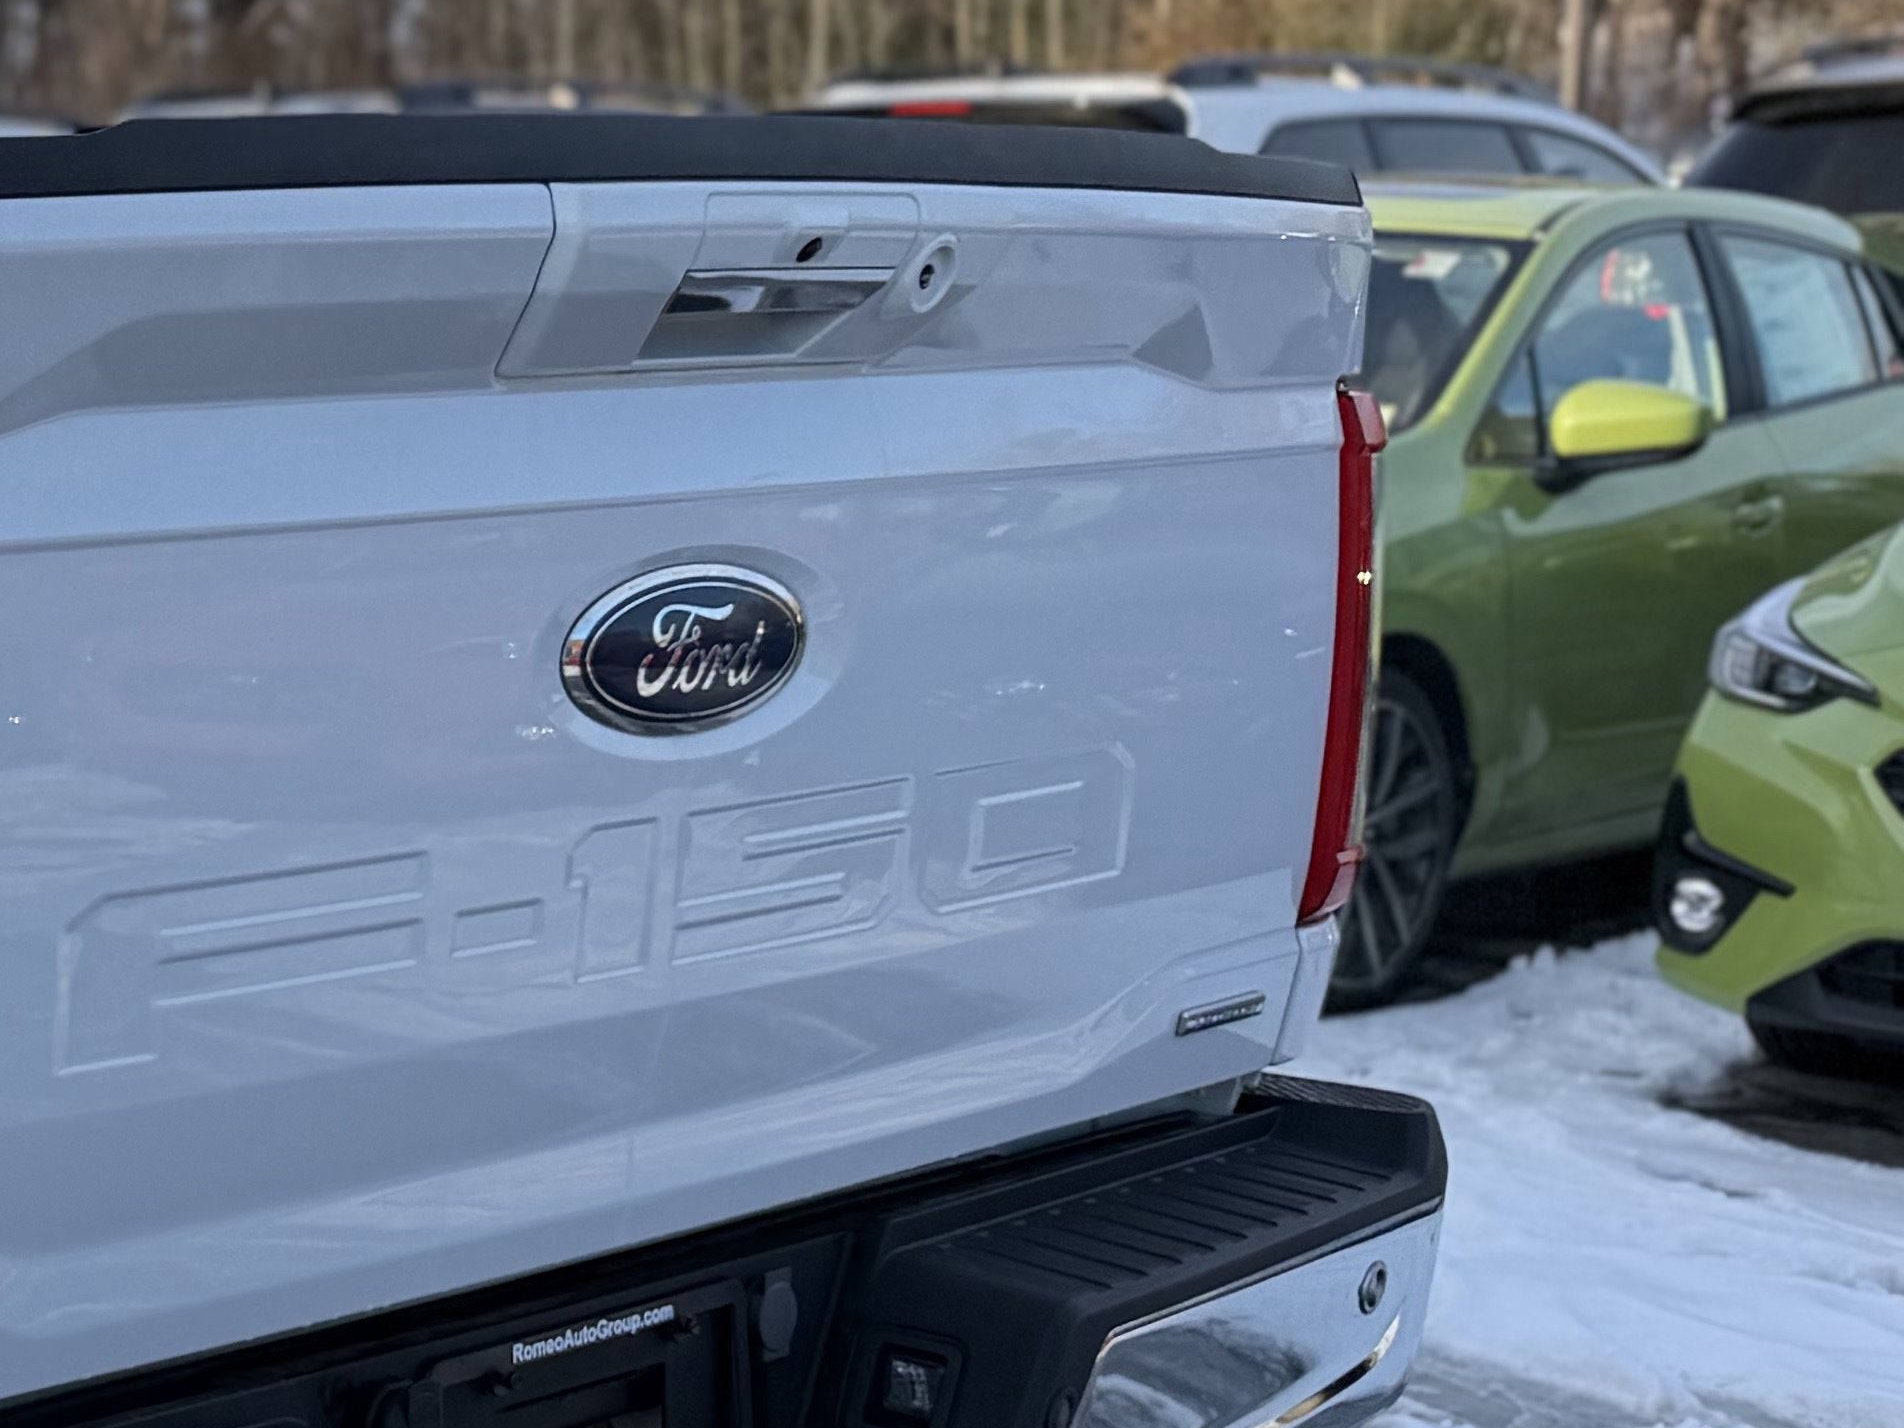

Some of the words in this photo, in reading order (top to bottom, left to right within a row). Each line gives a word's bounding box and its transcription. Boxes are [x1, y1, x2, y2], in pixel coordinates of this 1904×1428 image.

[637, 603, 766, 697] Ford
[54, 741, 1135, 1078] F-150
[513, 1304, 674, 1364] RomeoAutoGroup.com
